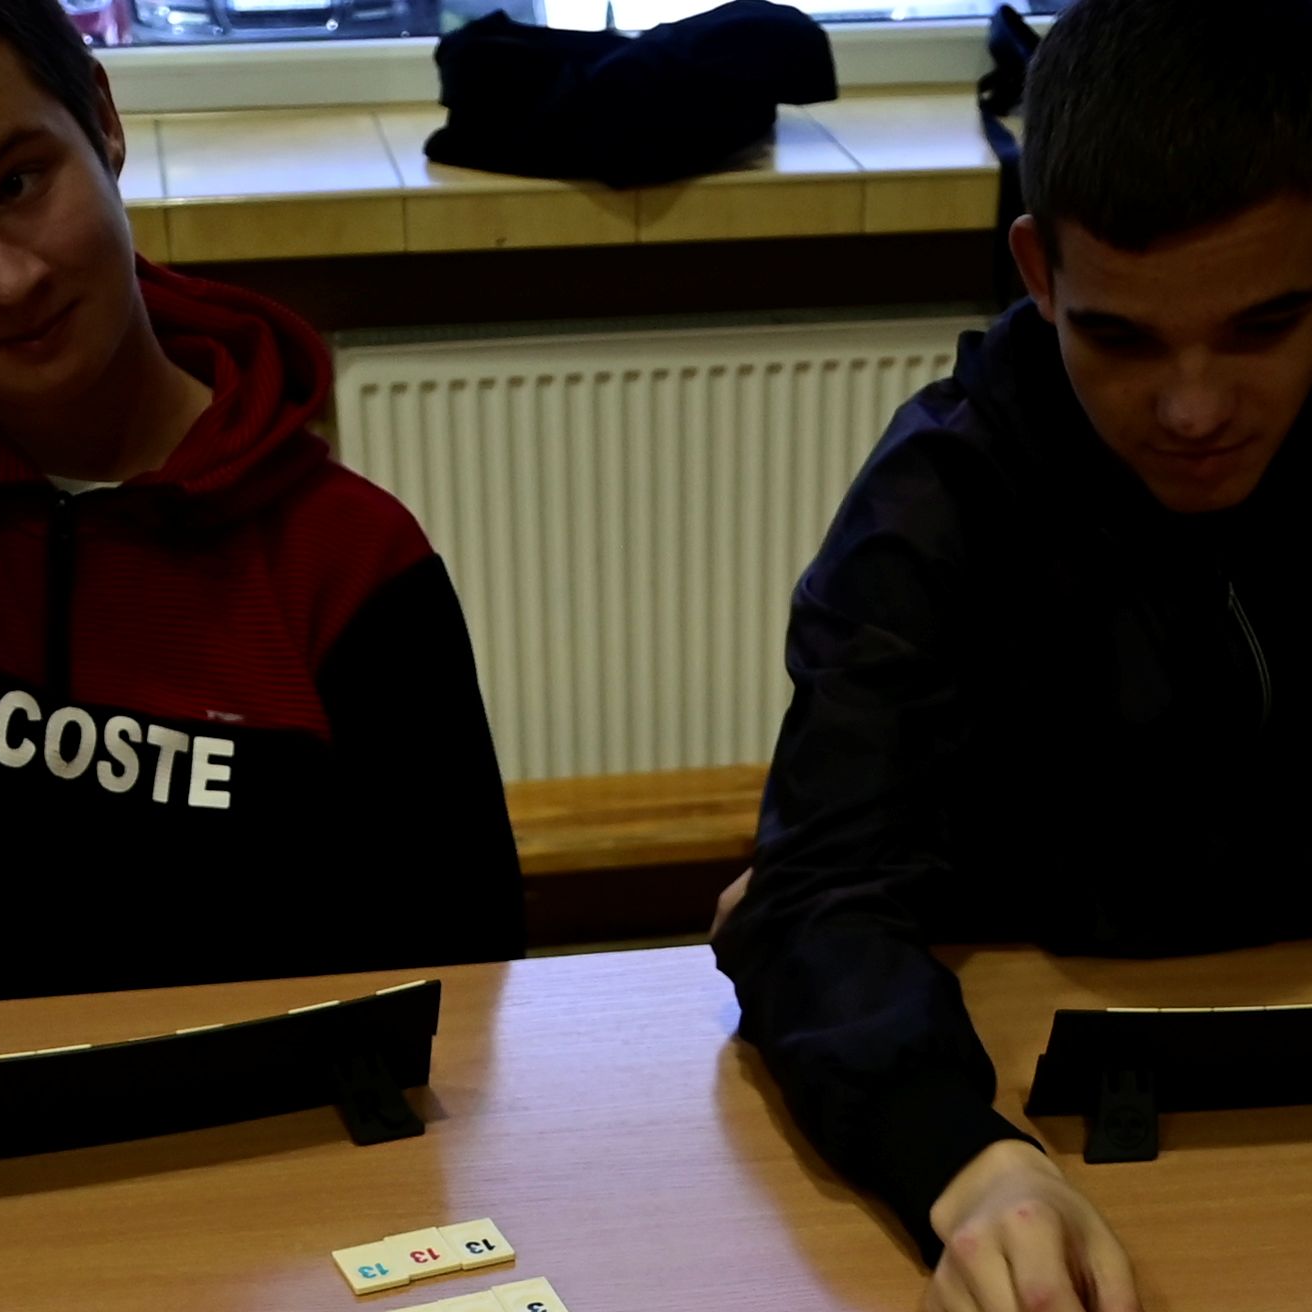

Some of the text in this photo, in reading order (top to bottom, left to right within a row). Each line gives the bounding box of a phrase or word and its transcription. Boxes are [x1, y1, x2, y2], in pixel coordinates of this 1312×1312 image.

[358, 1238, 495, 1278] 13 13 13
